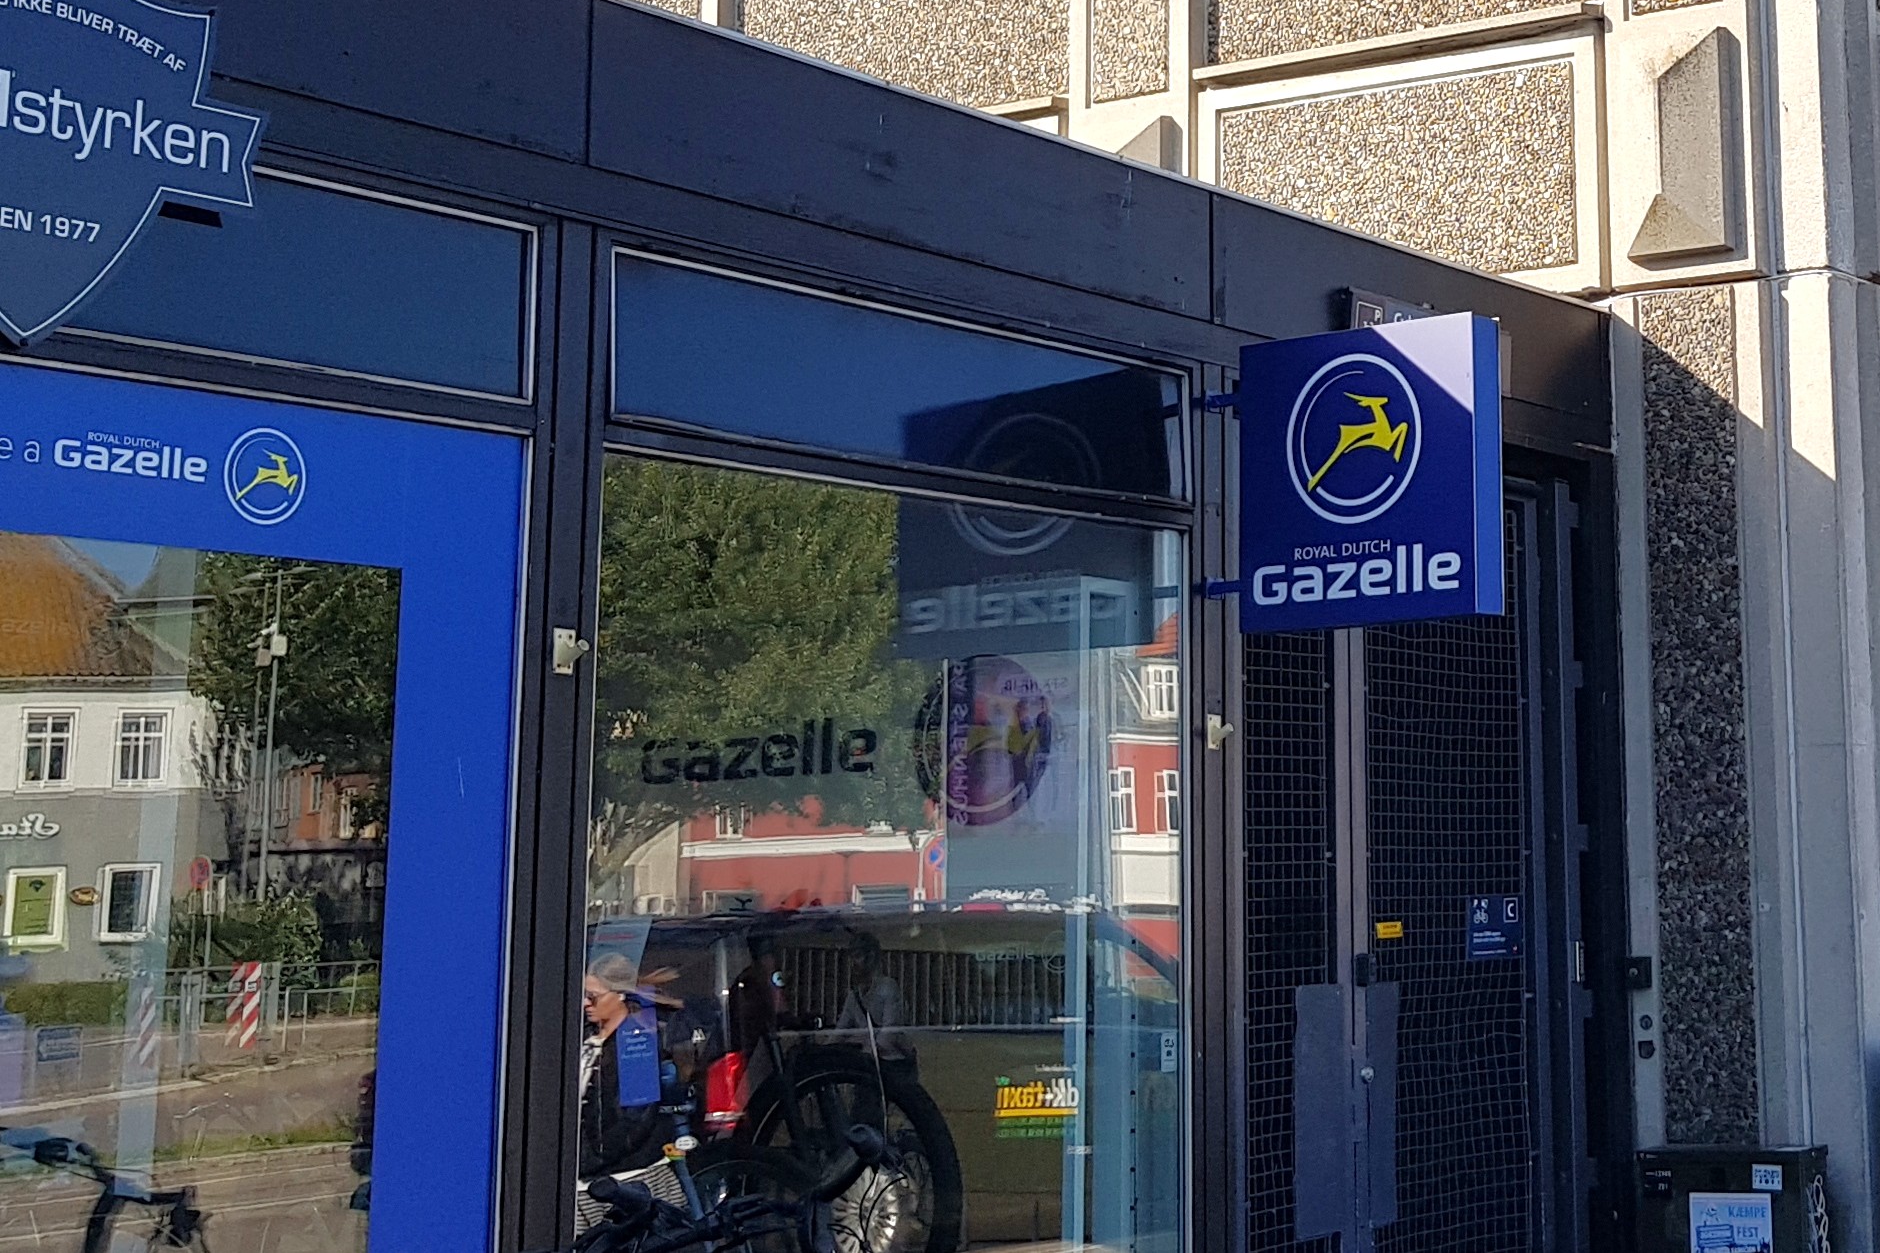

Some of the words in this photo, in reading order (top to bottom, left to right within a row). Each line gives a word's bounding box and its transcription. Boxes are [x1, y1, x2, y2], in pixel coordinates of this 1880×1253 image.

[56, 1, 114, 34] BLIVER
[117, 23, 164, 60] TRÆT
[162, 52, 187, 73] AF
[40, 214, 101, 242] 1977
[87, 431, 121, 445] ROYAL
[123, 435, 161, 449] DUTCH
[23, 440, 41, 463] a
[54, 438, 209, 483] Gazelle
[1293, 545, 1338, 561] ROYAL
[1342, 539, 1391, 557] DUTCH
[1252, 543, 1462, 606] Gazelle
[641, 717, 878, 785] Gazelle
[1727, 1205, 1767, 1219] KÆMPE
[1736, 1225, 1760, 1239] FEST
